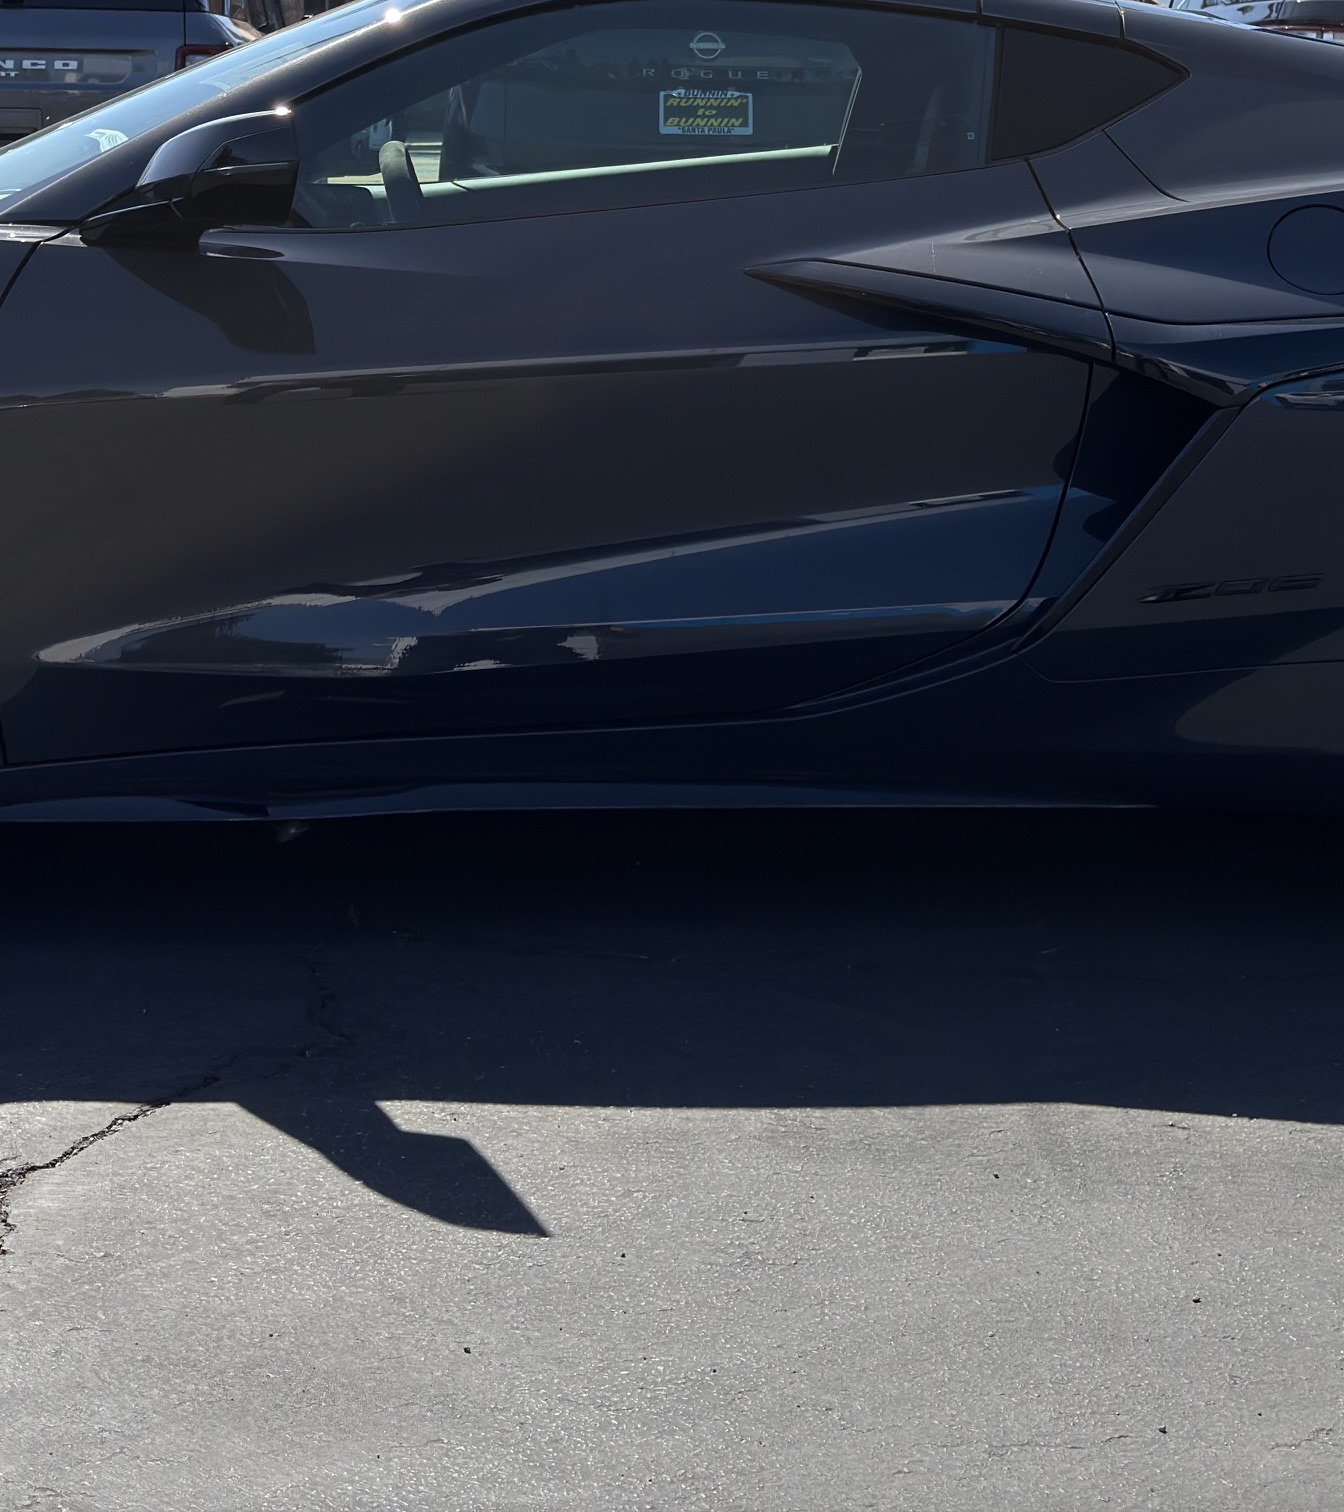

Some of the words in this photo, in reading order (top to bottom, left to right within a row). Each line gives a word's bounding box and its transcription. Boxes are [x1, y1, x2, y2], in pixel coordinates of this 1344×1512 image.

[642, 68, 769, 80] ROGUE
[684, 89, 728, 98] BUNNIN
[696, 108, 717, 116] to
[665, 117, 743, 127] BUNNIN
